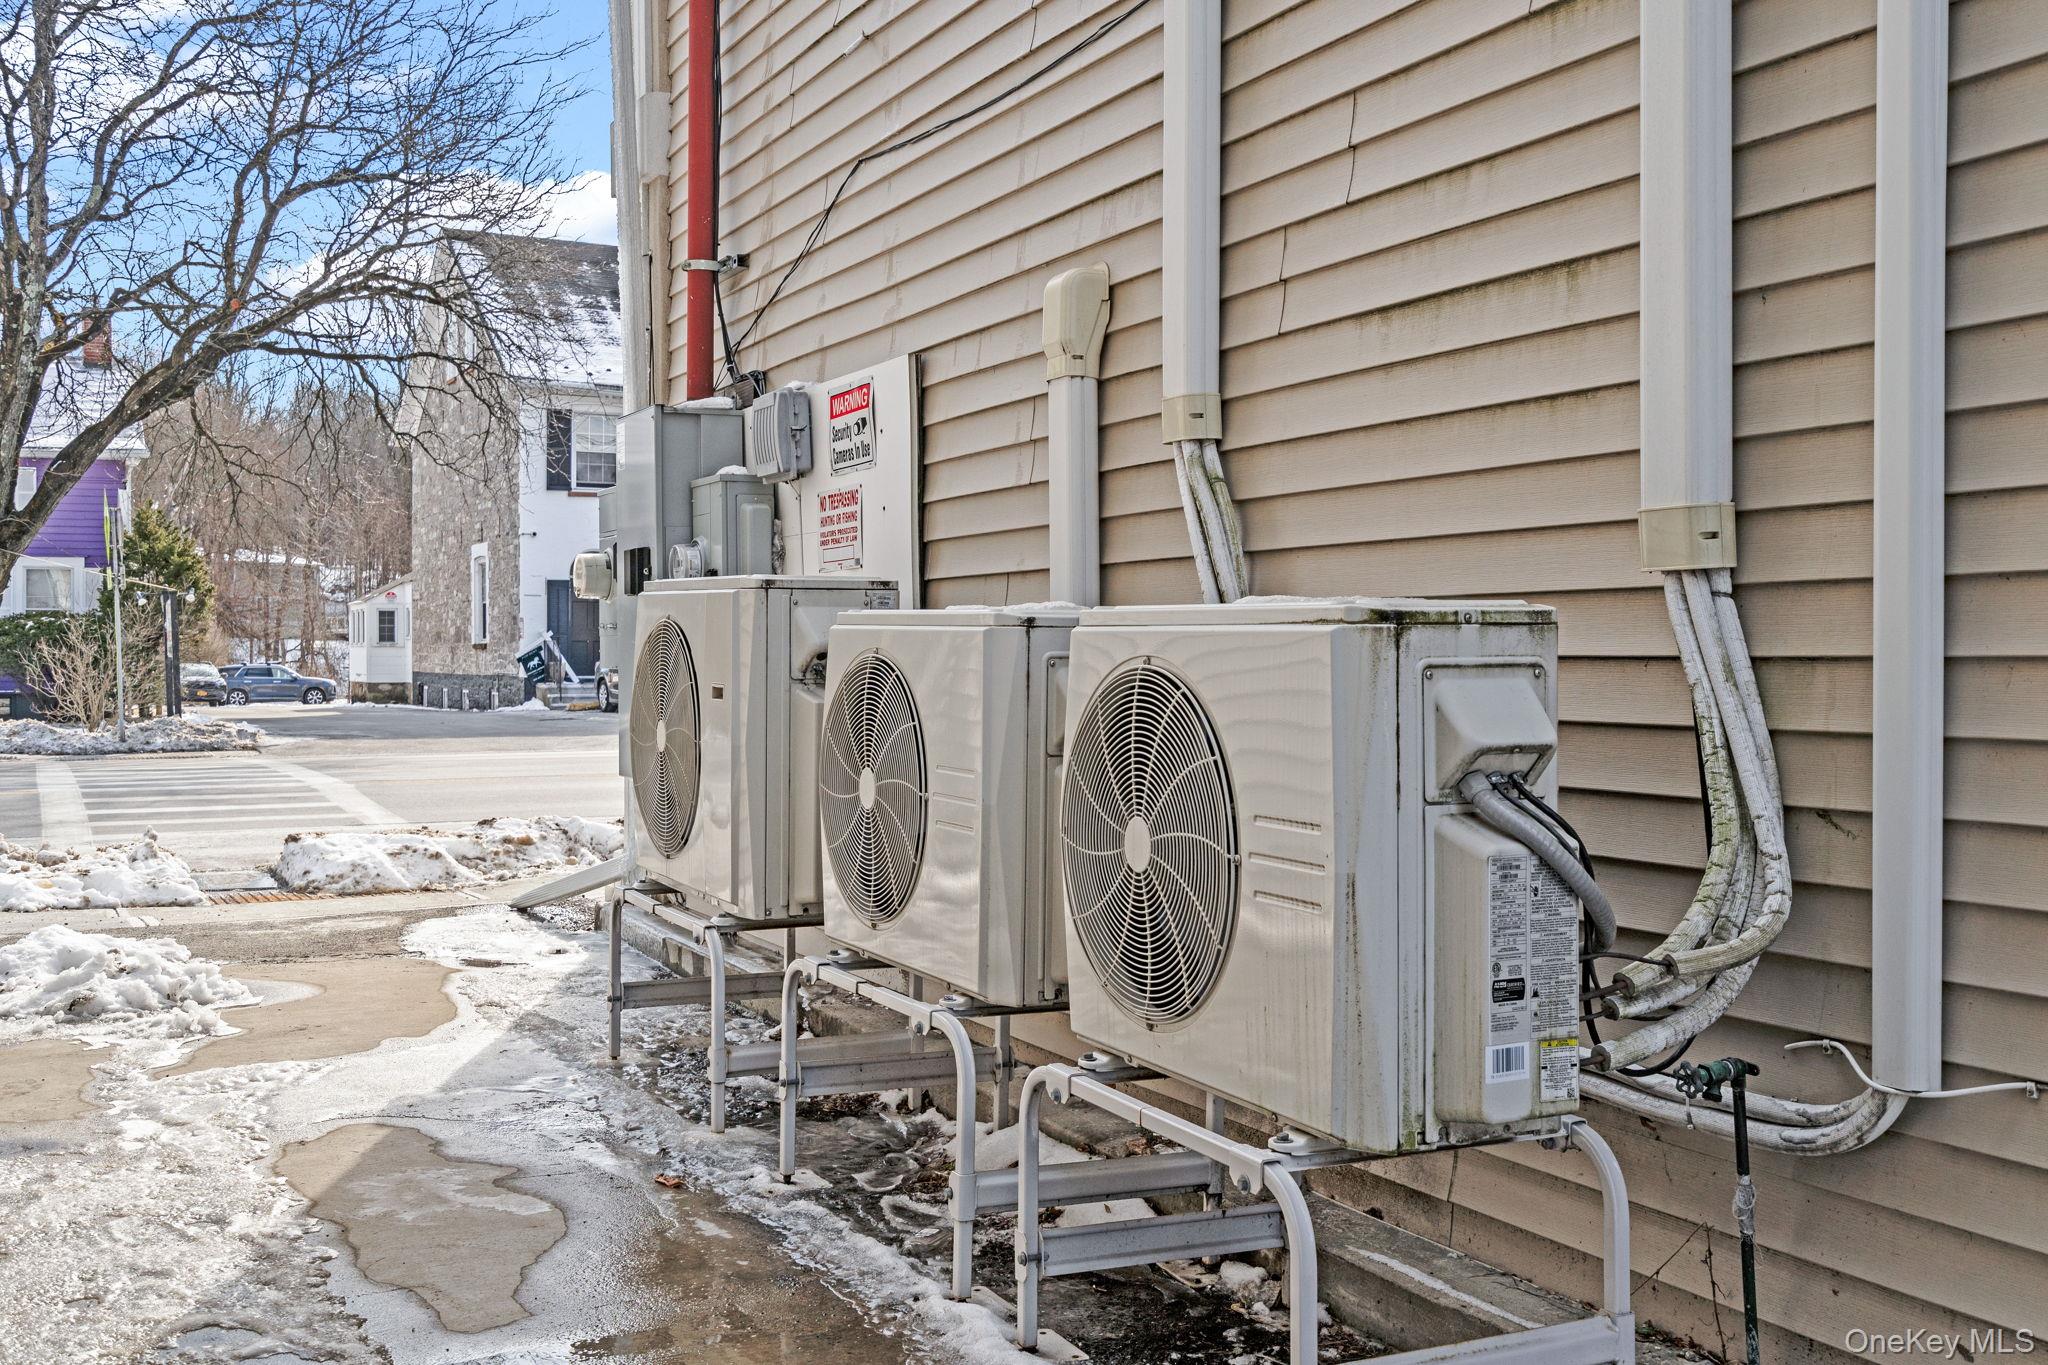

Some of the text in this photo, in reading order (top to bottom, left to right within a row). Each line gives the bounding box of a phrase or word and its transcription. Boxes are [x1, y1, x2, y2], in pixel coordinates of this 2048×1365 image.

[832, 388, 868, 416] WARNING
[832, 422, 852, 443] Security
[832, 440, 870, 465] Cameras In Use
[820, 489, 858, 512] NO TRESPASSING
[820, 510, 857, 528] HUNTING OR FISHING
